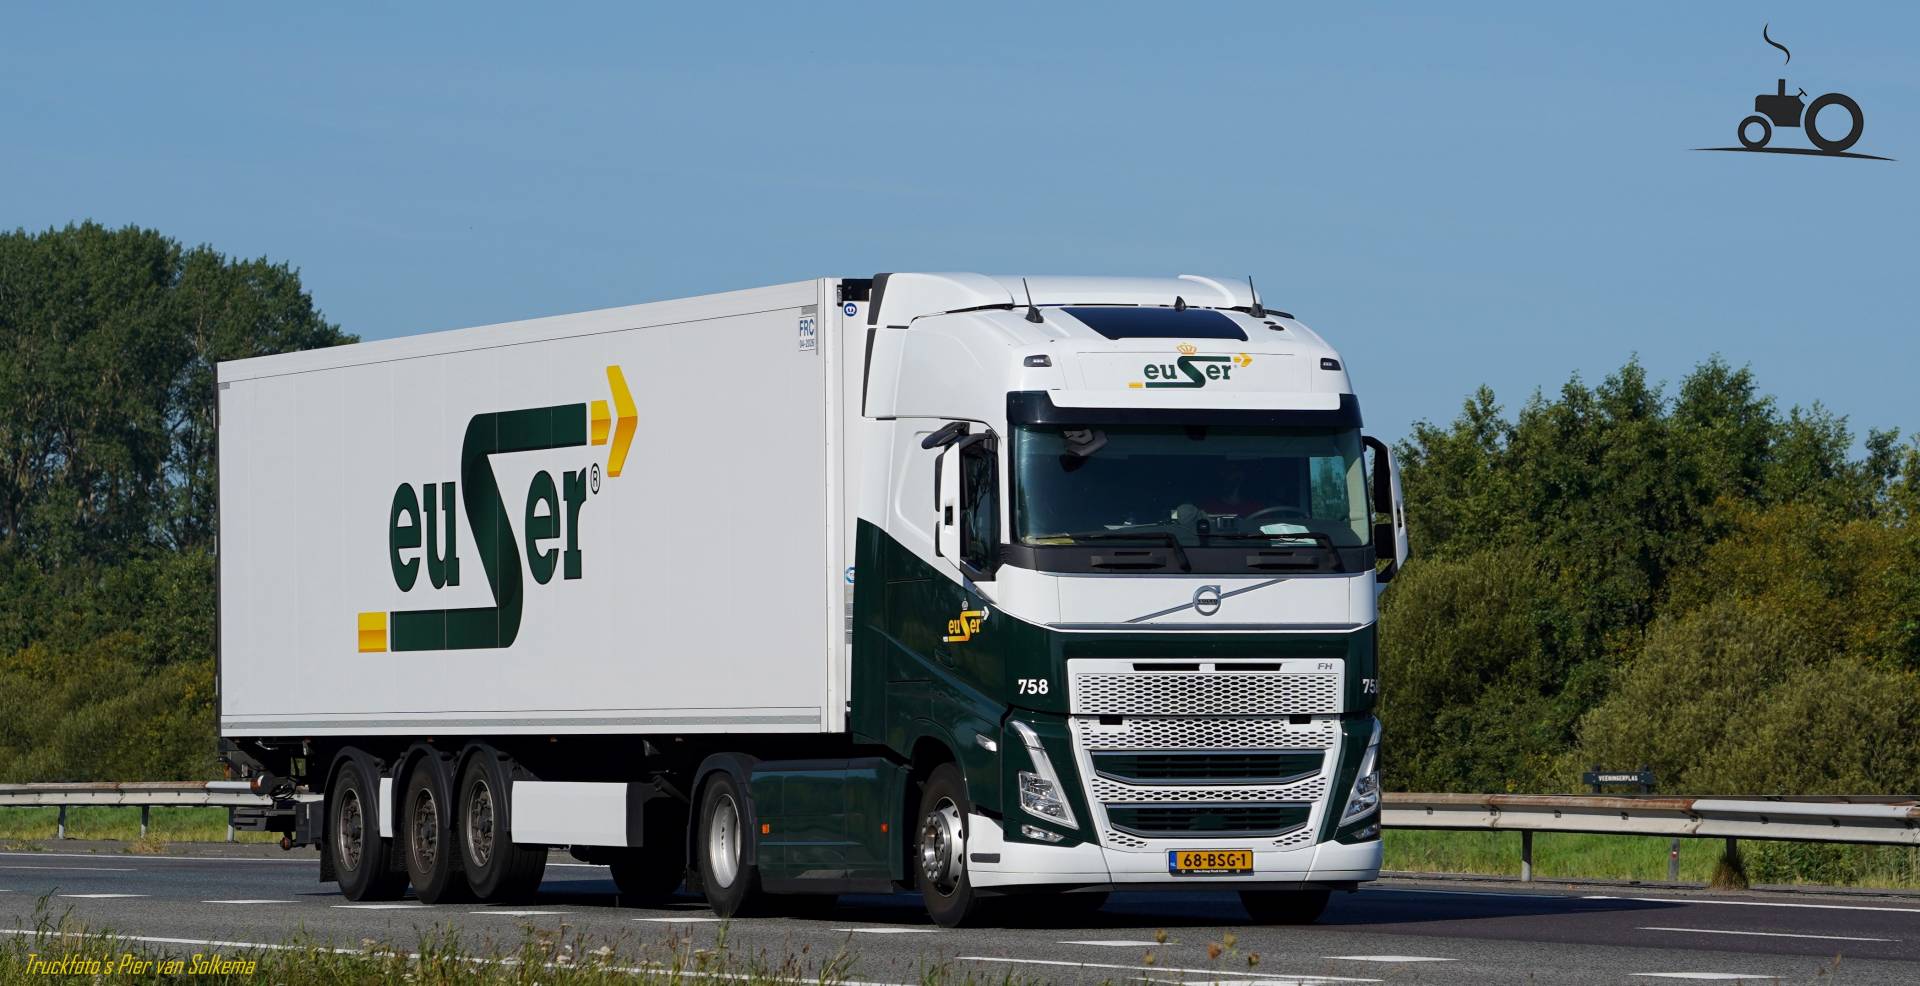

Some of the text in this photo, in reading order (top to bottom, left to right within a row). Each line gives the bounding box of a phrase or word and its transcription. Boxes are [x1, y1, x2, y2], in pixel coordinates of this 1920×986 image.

[799, 319, 815, 336] FRC
[1018, 679, 1049, 694] 758
[1184, 853, 1246, 867] 68-BSG-1
